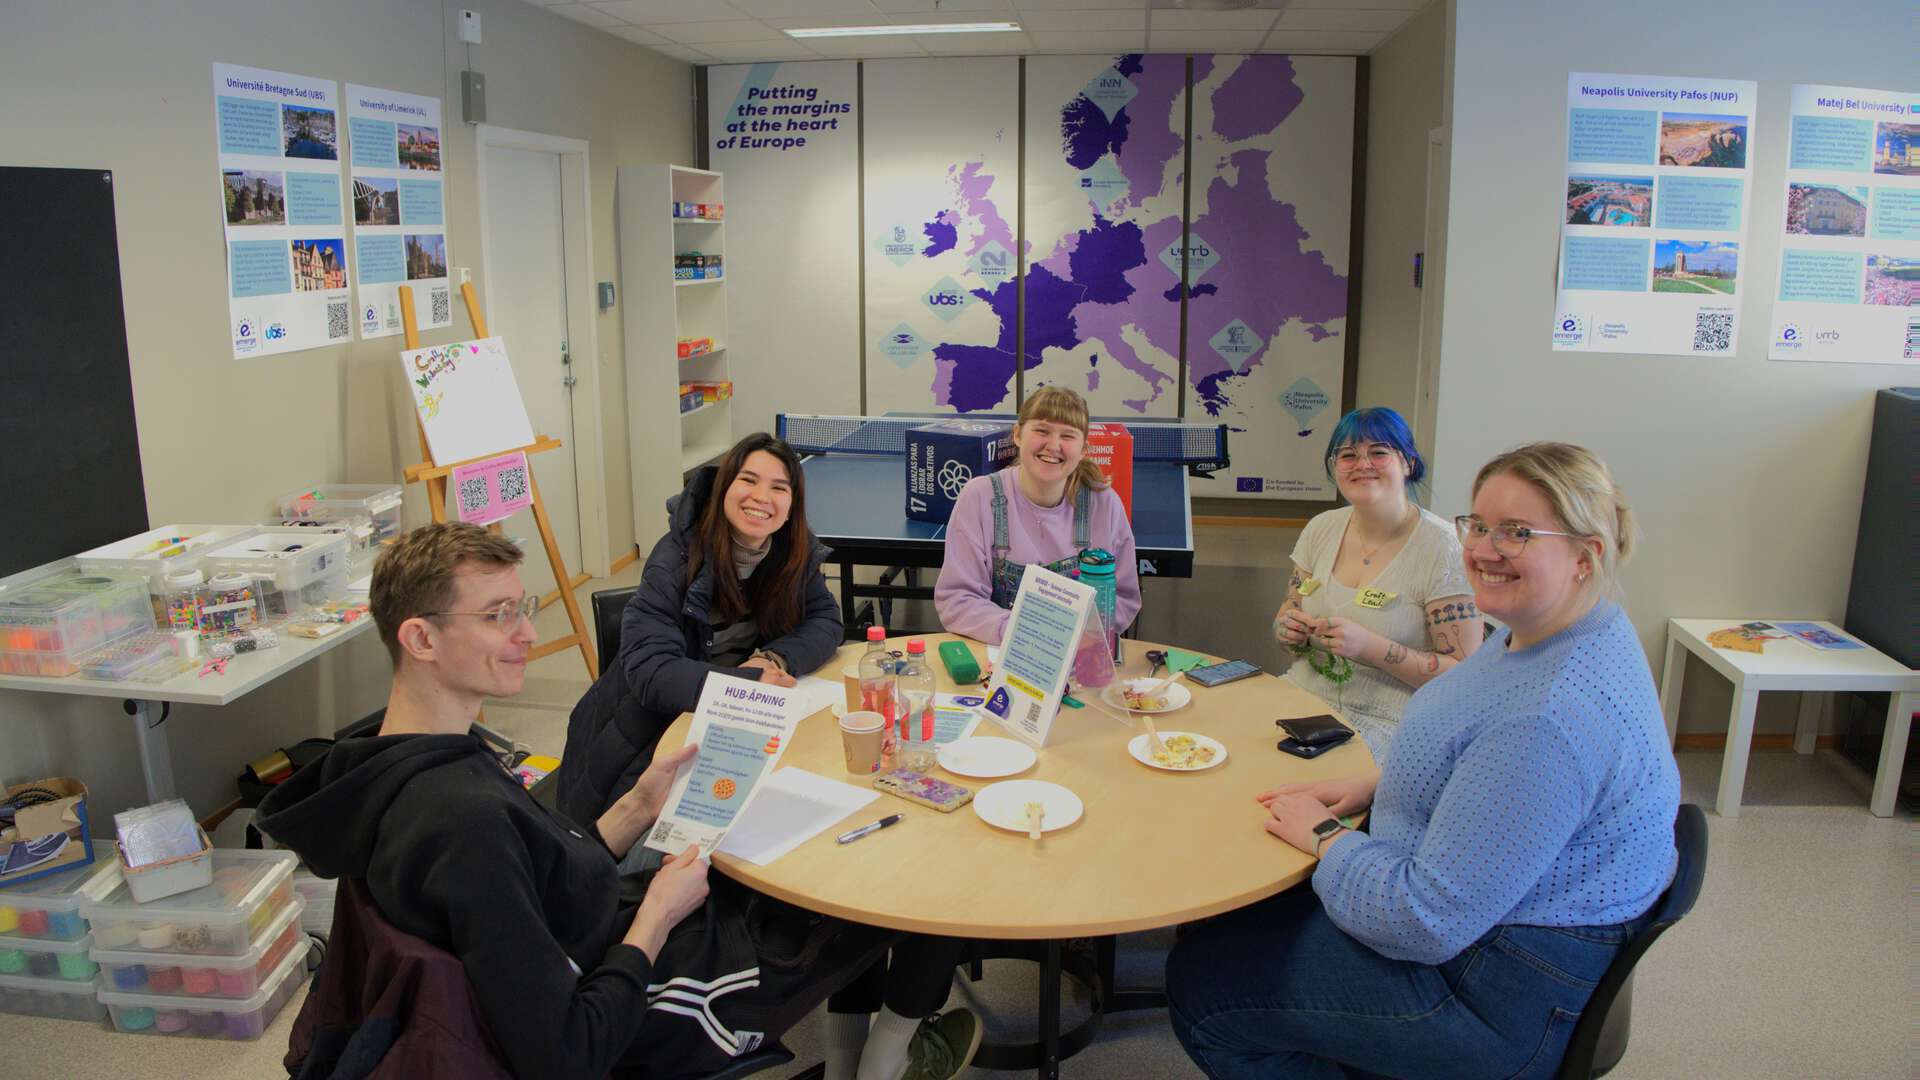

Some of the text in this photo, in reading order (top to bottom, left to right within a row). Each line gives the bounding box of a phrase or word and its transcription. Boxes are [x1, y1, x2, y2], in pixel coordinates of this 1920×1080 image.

[227, 78, 326, 102] Université Bretagne Sud (UBS)
[748, 86, 818, 101] Putting
[1582, 86, 1738, 103] Neapolis University Pafos (NUP)
[360, 99, 388, 112] University
[389, 102, 394, 111] of
[394, 104, 416, 114] Limerick
[737, 102, 851, 118] the margins
[1817, 98, 1844, 110] Matej
[1846, 99, 1860, 109] Bel
[1862, 100, 1905, 114] University
[727, 118, 838, 133] at the heart
[717, 136, 806, 151] of Europe
[1554, 332, 1582, 340] emerge
[987, 440, 996, 462] 17
[926, 445, 934, 496] LOS OBJETIVOS
[918, 468, 926, 494] LOGRAR
[911, 497, 927, 512] 17
[725, 686, 786, 707] HUB-ÅPNING
